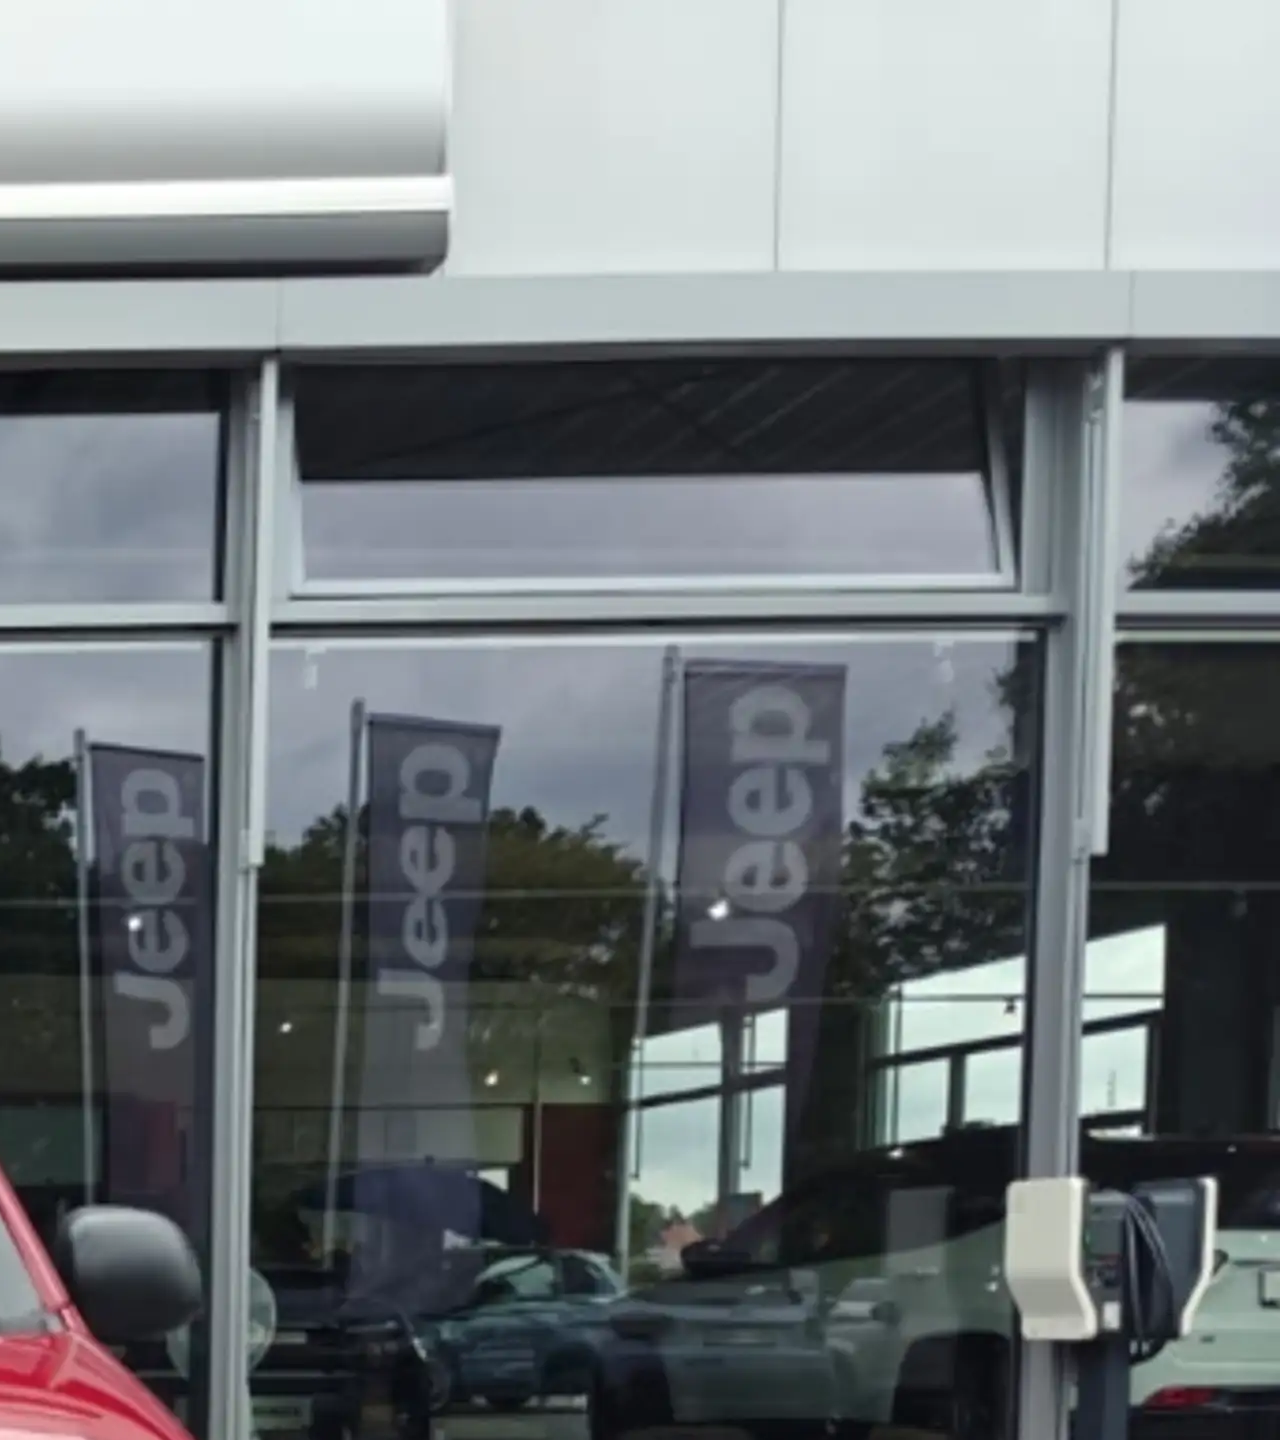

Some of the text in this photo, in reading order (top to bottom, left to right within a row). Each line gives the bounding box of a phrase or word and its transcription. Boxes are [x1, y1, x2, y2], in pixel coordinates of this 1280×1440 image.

[113, 766, 195, 1051] Jeep
[378, 742, 482, 1051] Jeep
[690, 683, 830, 1002] Jeep
